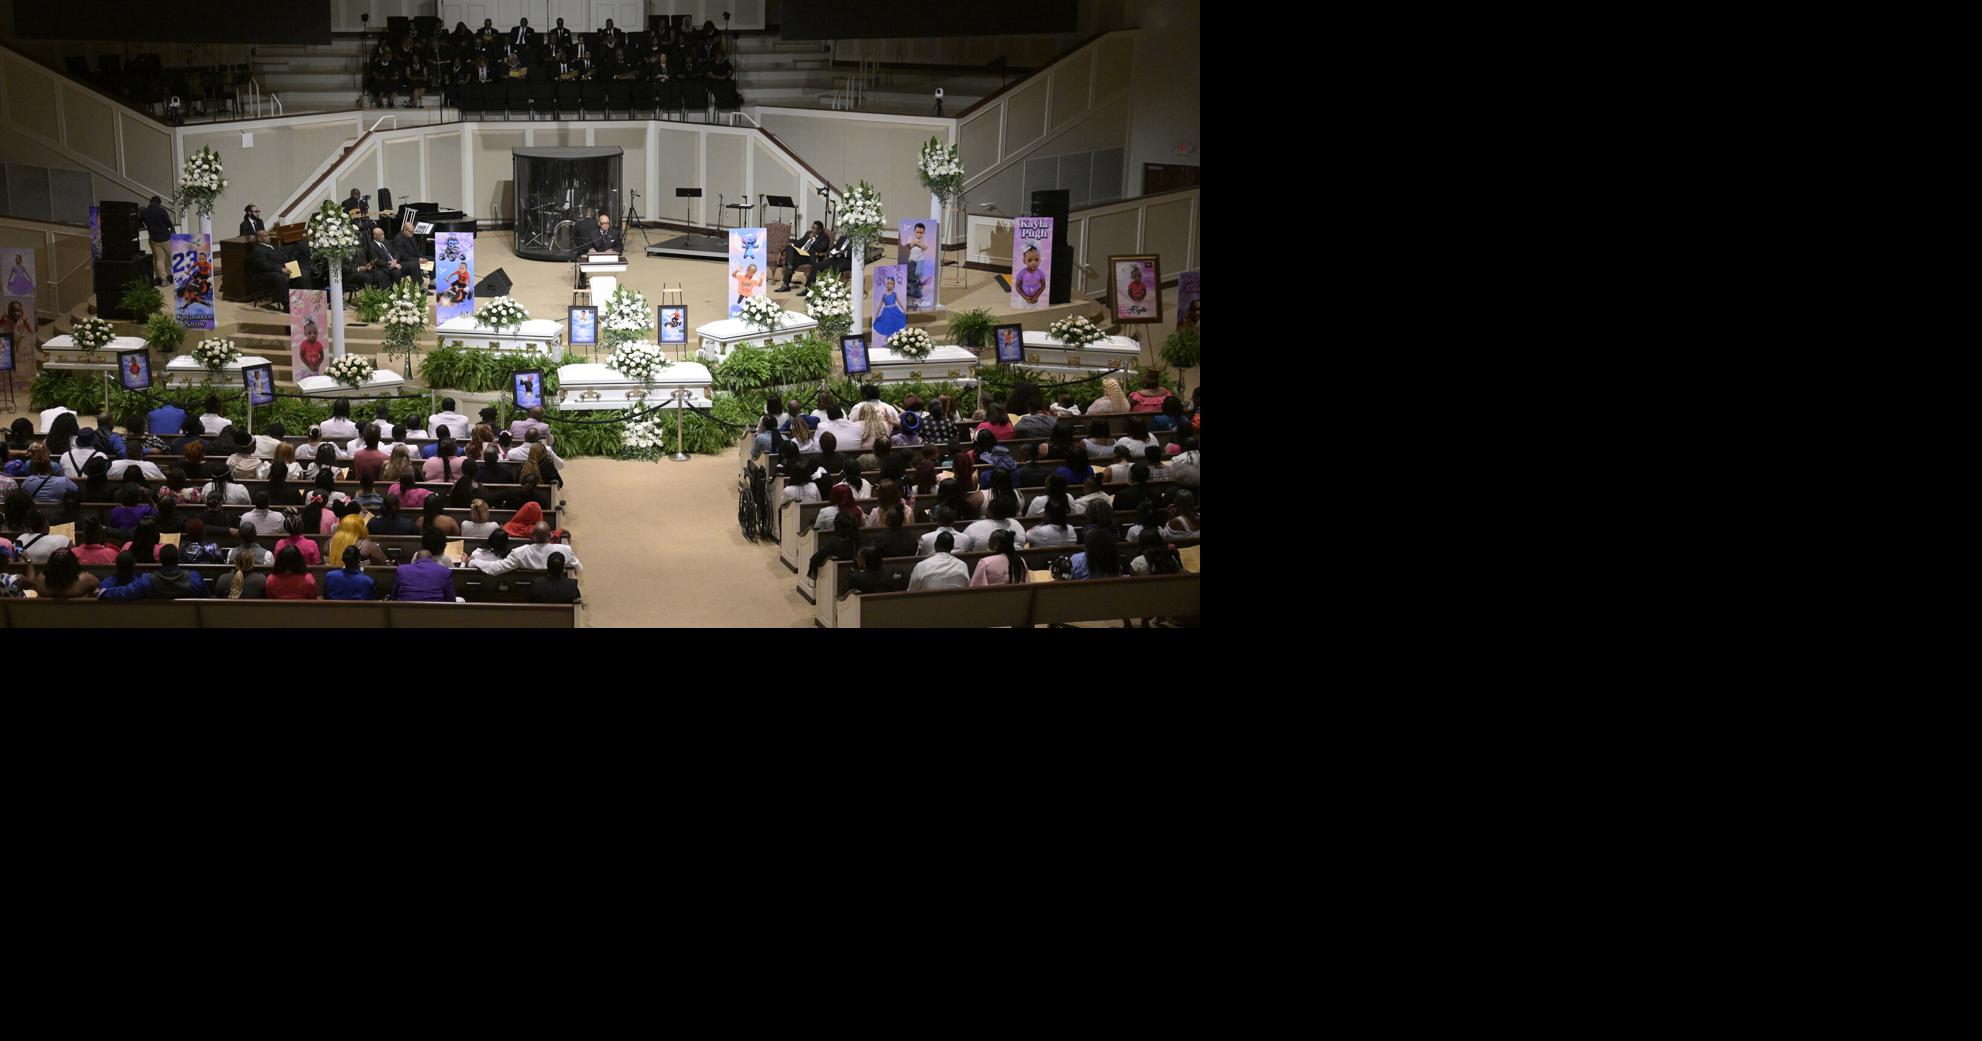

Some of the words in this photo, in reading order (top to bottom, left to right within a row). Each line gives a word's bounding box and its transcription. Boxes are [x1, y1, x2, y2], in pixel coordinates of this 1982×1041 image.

[1019, 219, 1048, 230] Kayla
[1021, 229, 1048, 240] Pugh
[172, 250, 197, 273] 23
